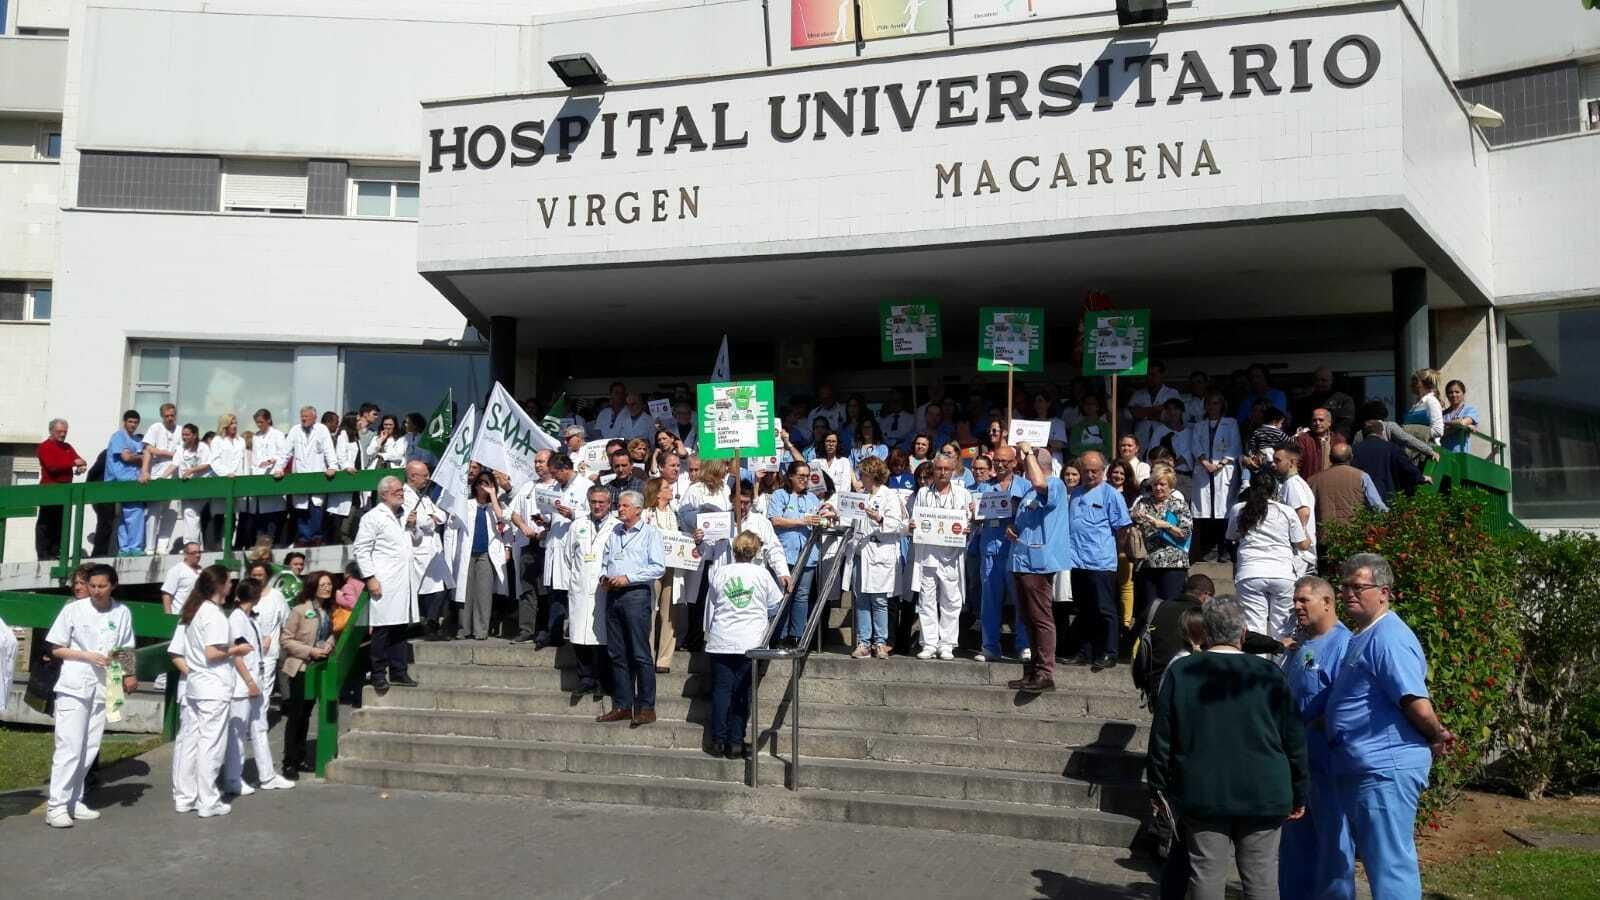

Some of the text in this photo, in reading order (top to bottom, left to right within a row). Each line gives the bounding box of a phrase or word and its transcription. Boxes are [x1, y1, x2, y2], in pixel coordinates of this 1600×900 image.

[428, 34, 1381, 173] HOSPITAL UNIVERSITARIO
[537, 139, 1221, 229] VIRGEN MACARENA
